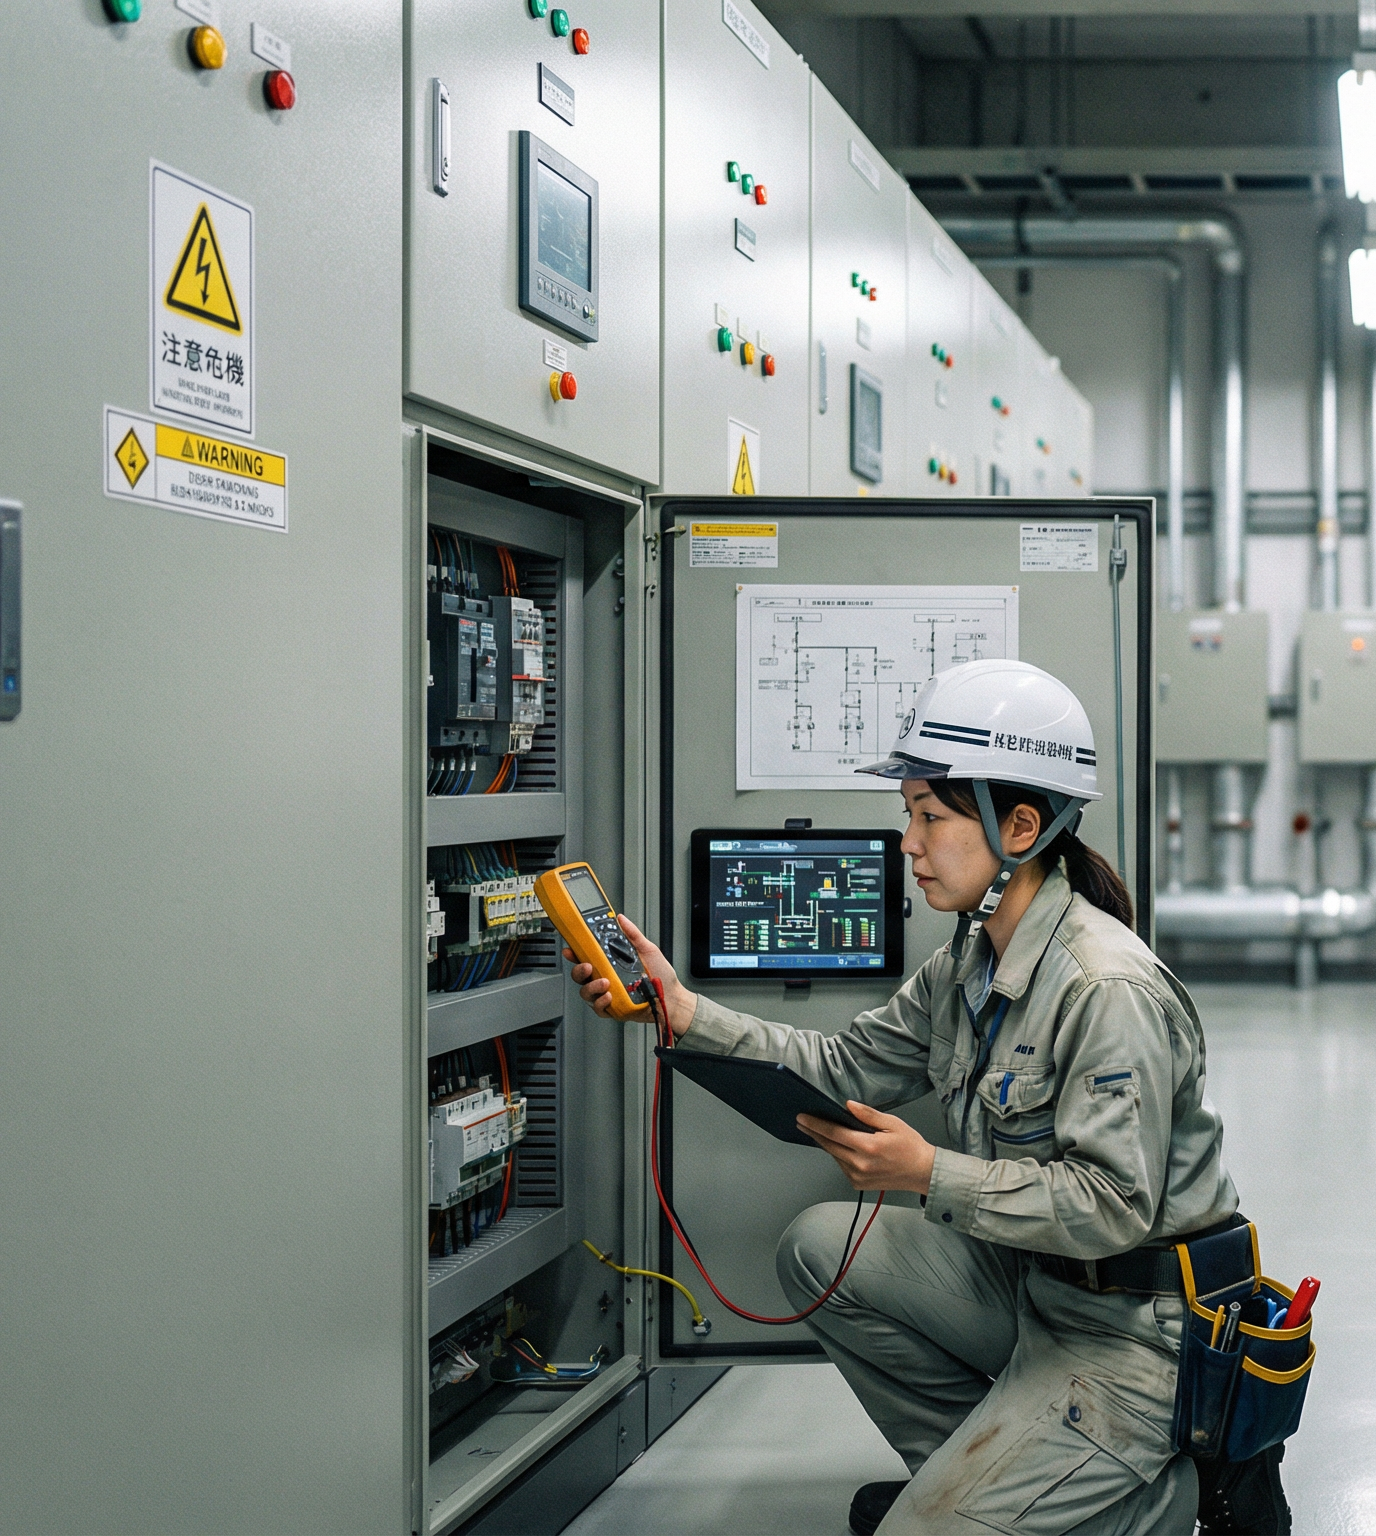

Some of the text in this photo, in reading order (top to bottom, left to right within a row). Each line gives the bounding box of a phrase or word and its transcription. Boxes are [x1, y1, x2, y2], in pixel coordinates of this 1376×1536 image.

[162, 331, 244, 387] 注意危機
[197, 439, 264, 476] WARNING
